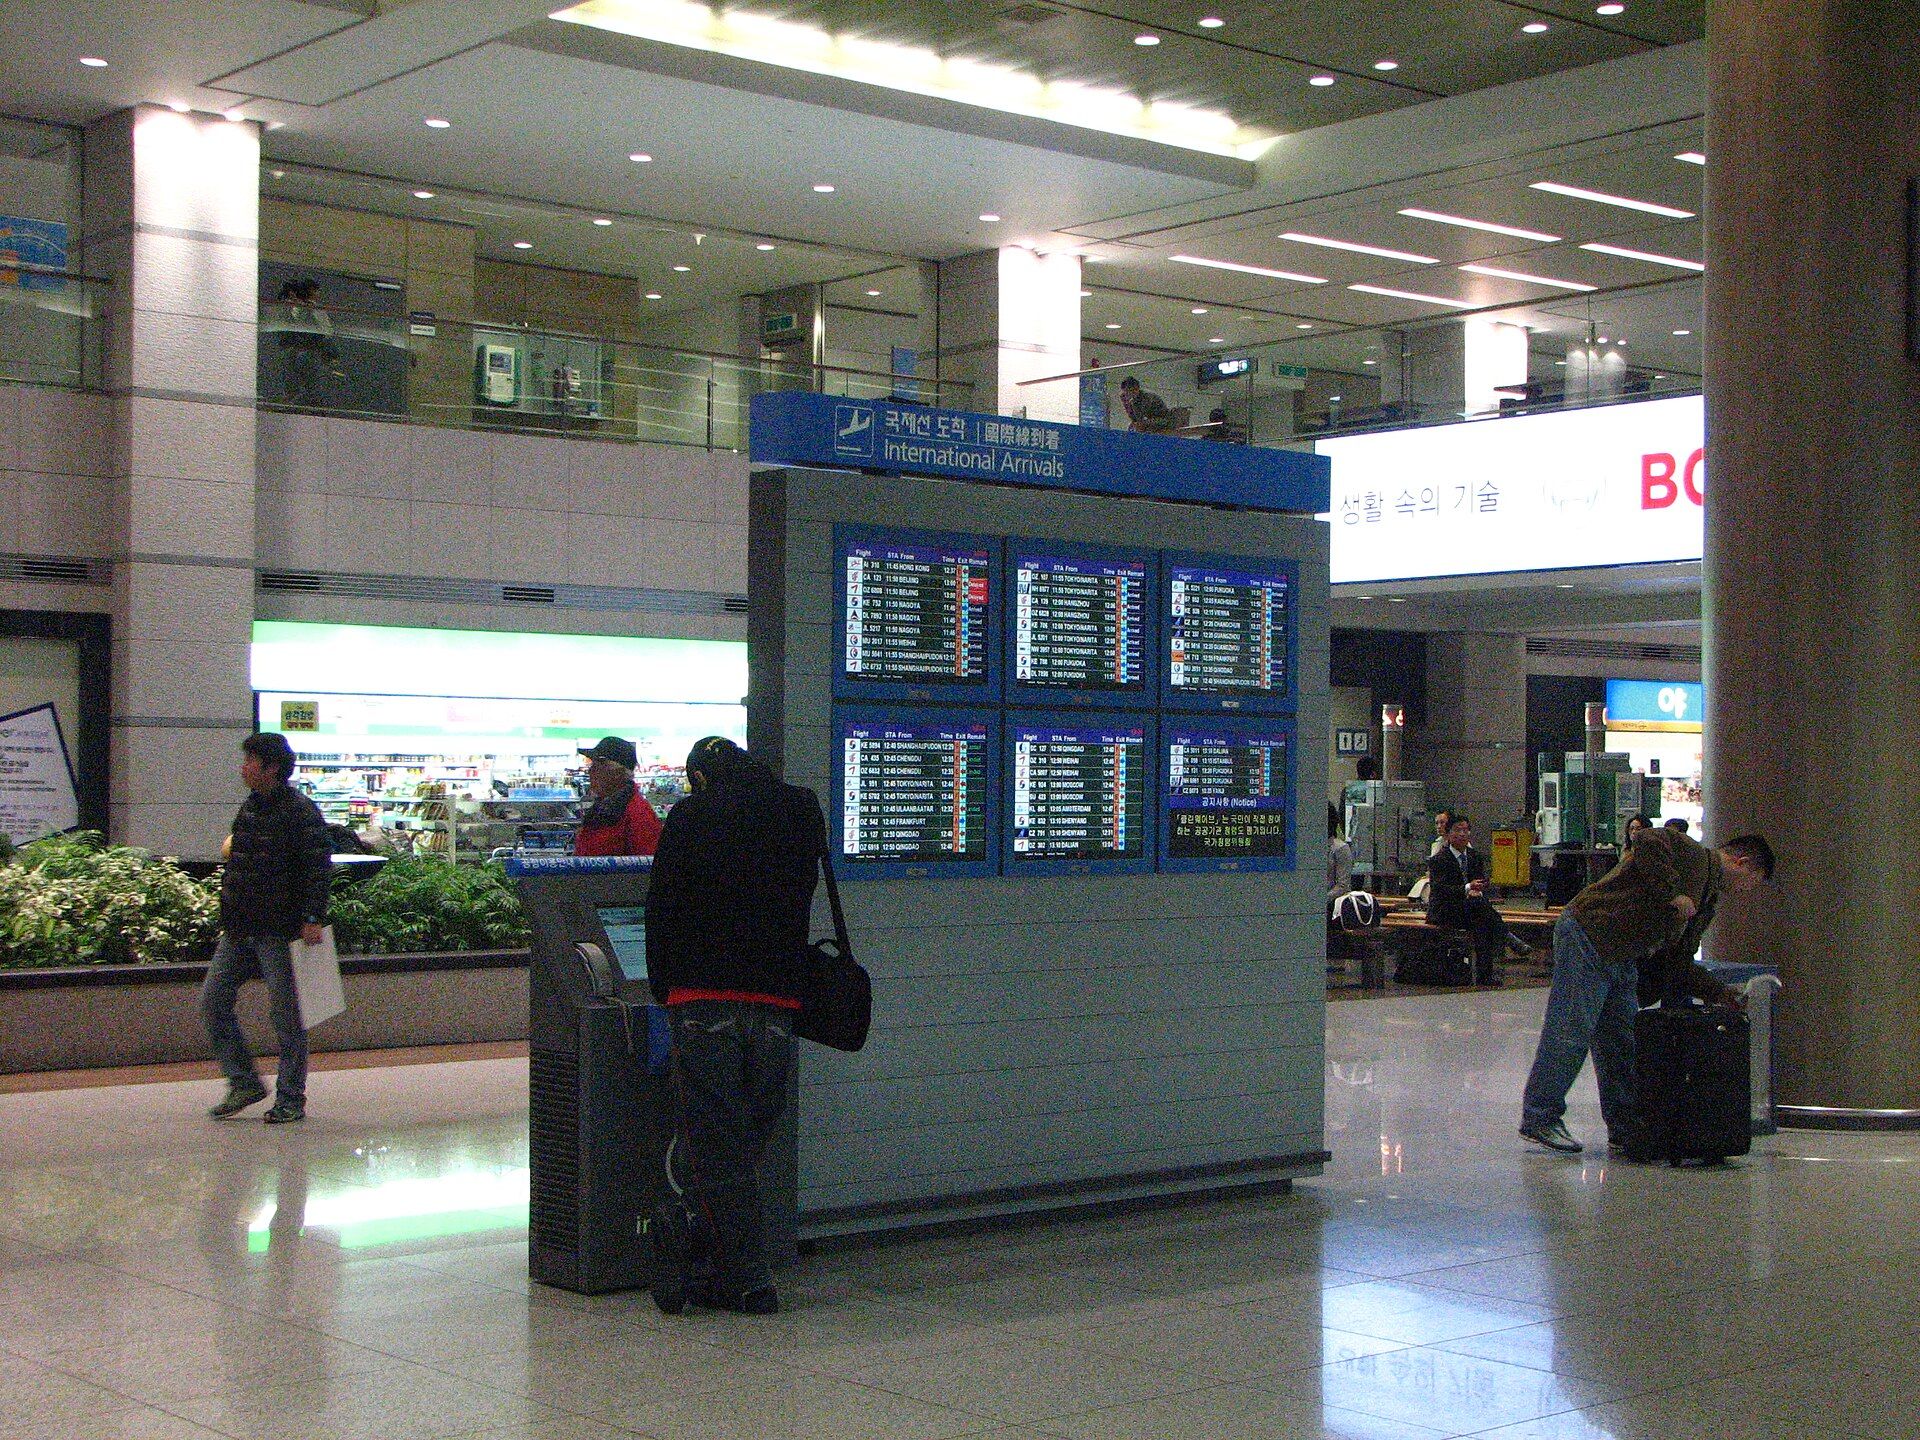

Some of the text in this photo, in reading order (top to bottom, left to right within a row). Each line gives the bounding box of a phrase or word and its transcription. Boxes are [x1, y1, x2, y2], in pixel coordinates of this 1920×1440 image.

[886, 410, 965, 440] 국제선 도착
[984, 422, 1061, 450] 國際線到着
[884, 438, 1064, 478] International Arrivals
[1340, 480, 1500, 525] 생활 속의 기술
[856, 549, 871, 557] Flight
[899, 563, 930, 573] HONG KONG
[863, 573, 983, 589] CA BEIJING Delayed
[1064, 576, 1098, 585] TOKYO/NARITA
[863, 586, 983, 602] OZ BEIJING Delayed
[1064, 588, 1098, 597] TOKYO/NARITA
[1215, 587, 1235, 595] FUKUOKA
[863, 599, 921, 610] KE NAGOYA
[1064, 600, 1089, 608] HANGZHOU
[899, 614, 921, 622] NAGOYA
[1064, 612, 1089, 620] HANGZHOU
[899, 626, 921, 635] NAGOYA
[1064, 624, 1098, 632] TOKYO/NARITA
[1064, 636, 1098, 644] TOKYO/NARITA
[1214, 632, 1240, 640] GUANGZHOU
[899, 639, 917, 647] WEIHAI
[1064, 648, 1098, 656] TOKYO/NARITA
[943, 654, 955, 662] 12:12
[1064, 660, 1086, 668] FUKUOKA
[943, 666, 954, 674] 12:12
[1064, 672, 1086, 680] FUKUOKA
[853, 730, 869, 738] Flight
[861, 767, 922, 775] OZ 12:45 CHENGDU
[883, 780, 896, 788] 12:45
[897, 780, 934, 788] TOKYO/NARITA
[941, 780, 953, 788] 12:44
[941, 793, 953, 801] 12:44
[1202, 797, 1257, 808] 공지사항 (Notice)
[883, 805, 896, 813] 12:45
[896, 805, 934, 813] ULAANBAATAR
[869, 818, 879, 826] 542
[883, 818, 896, 826] 12:45
[896, 818, 926, 826] FRANKFURT
[1221, 814, 1229, 824] 는
[1230, 814, 1251, 824] 국민이
[1252, 814, 1266, 824] 직접
[1268, 814, 1281, 824] 참여
[1176, 826, 1190, 835] 하는
[1194, 826, 1222, 835] 공공기관
[860, 843, 868, 851] OZ
[896, 843, 920, 851] QINGDAO
[579, 857, 611, 867] KIOSK
